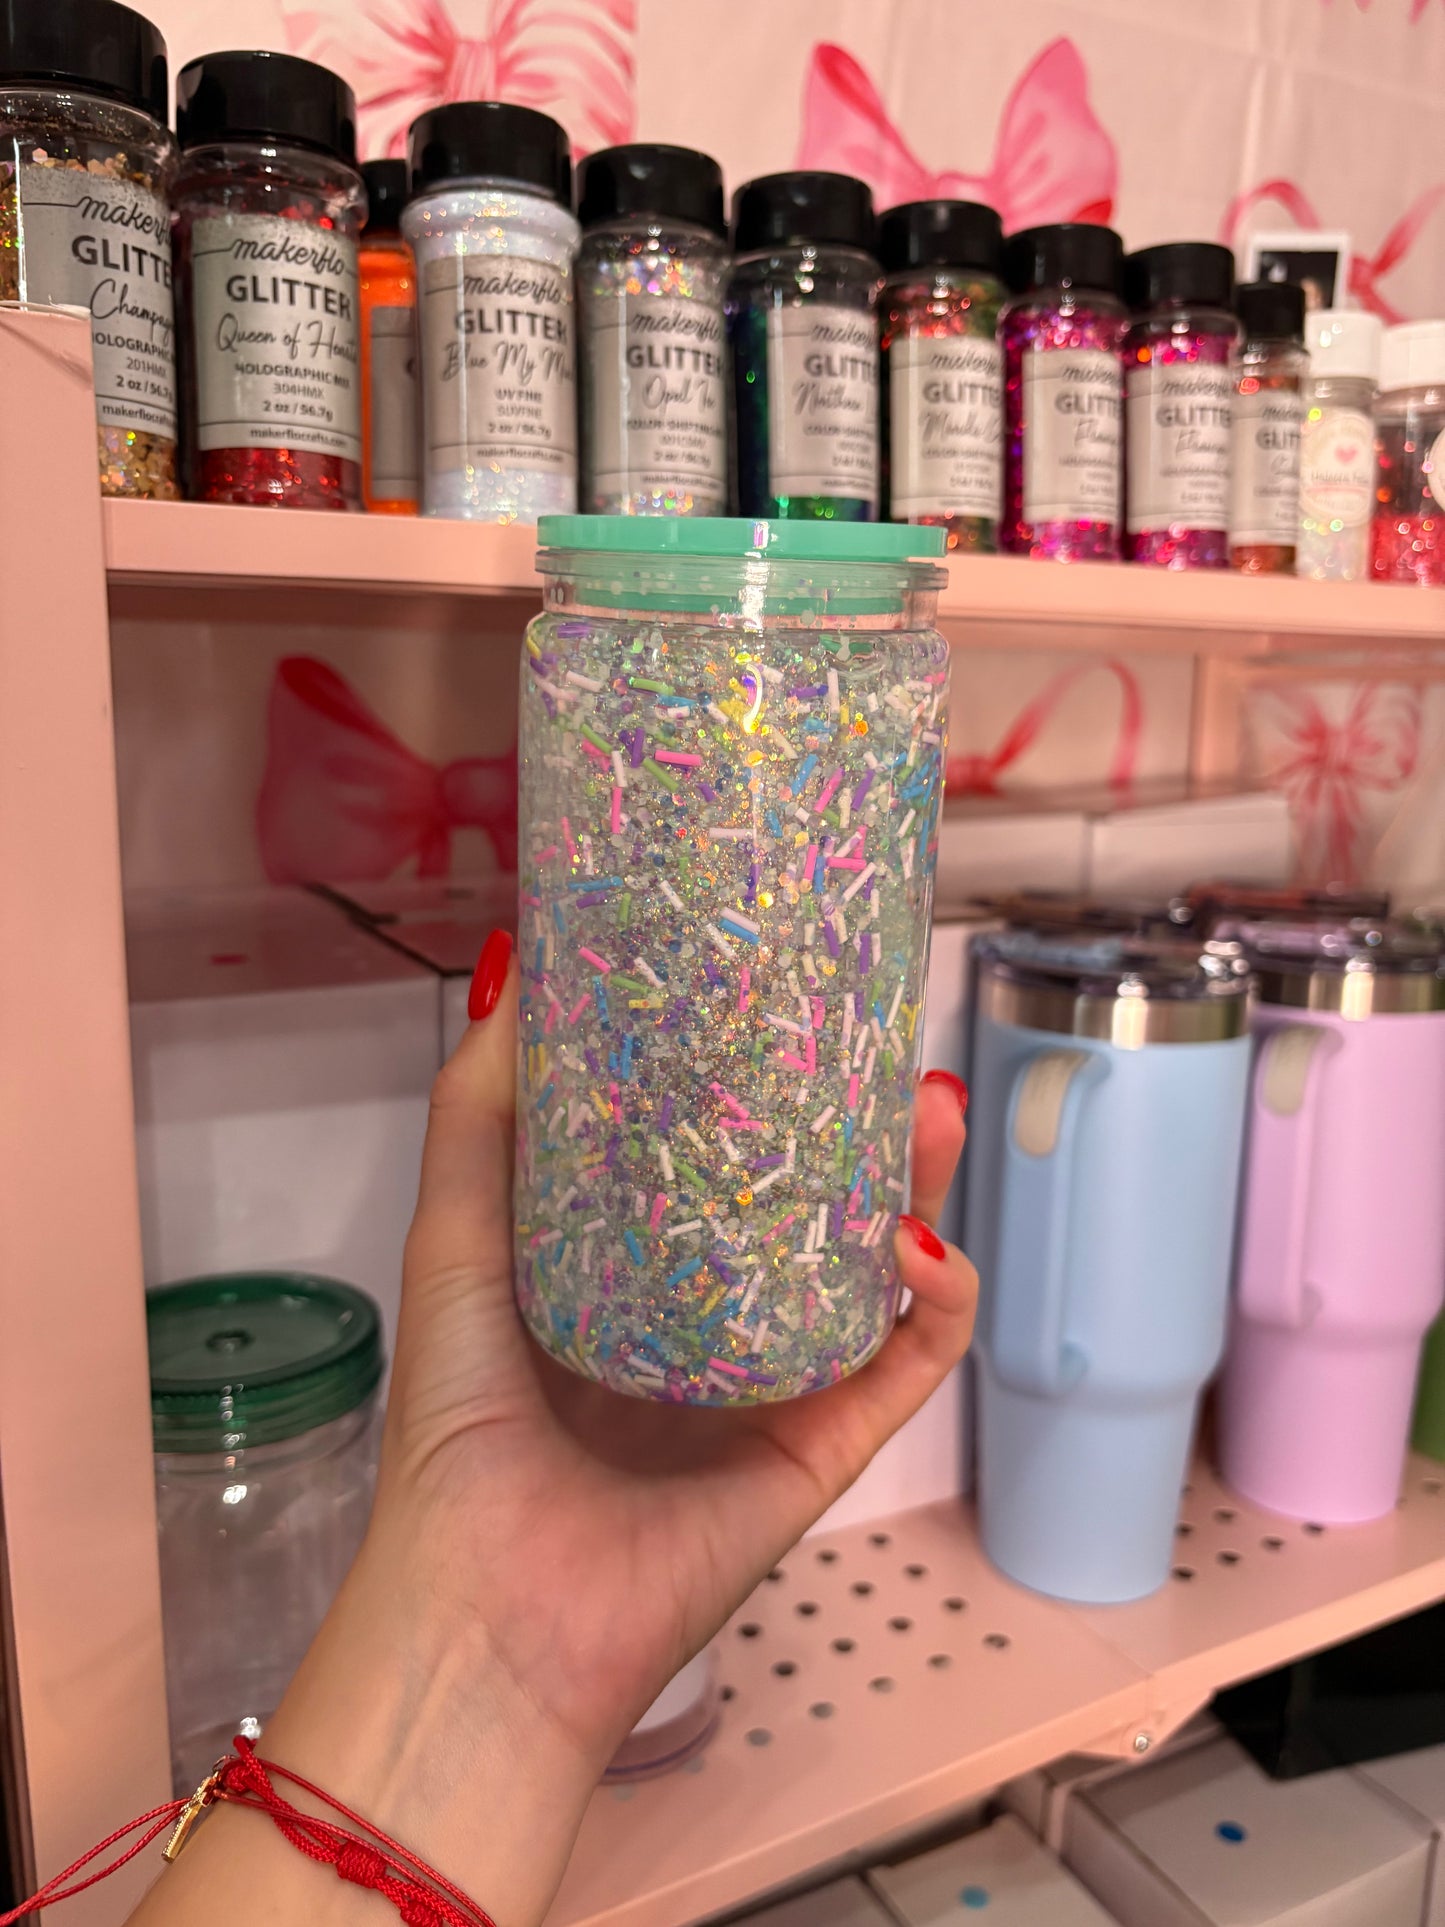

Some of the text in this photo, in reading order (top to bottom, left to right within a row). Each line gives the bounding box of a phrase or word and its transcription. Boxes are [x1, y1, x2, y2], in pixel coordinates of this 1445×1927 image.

[79, 196, 171, 245] makerfl
[71, 234, 172, 289] GLITTE
[231, 236, 345, 276] makerflo
[226, 274, 352, 321] GLITTER
[217, 313, 276, 353] Queen
[284, 322, 301, 360] of
[455, 308, 568, 345] GLITTER
[116, 375, 124, 388] 2
[127, 380, 142, 391] oz
[263, 401, 271, 412] 2
[275, 403, 289, 413] oz
